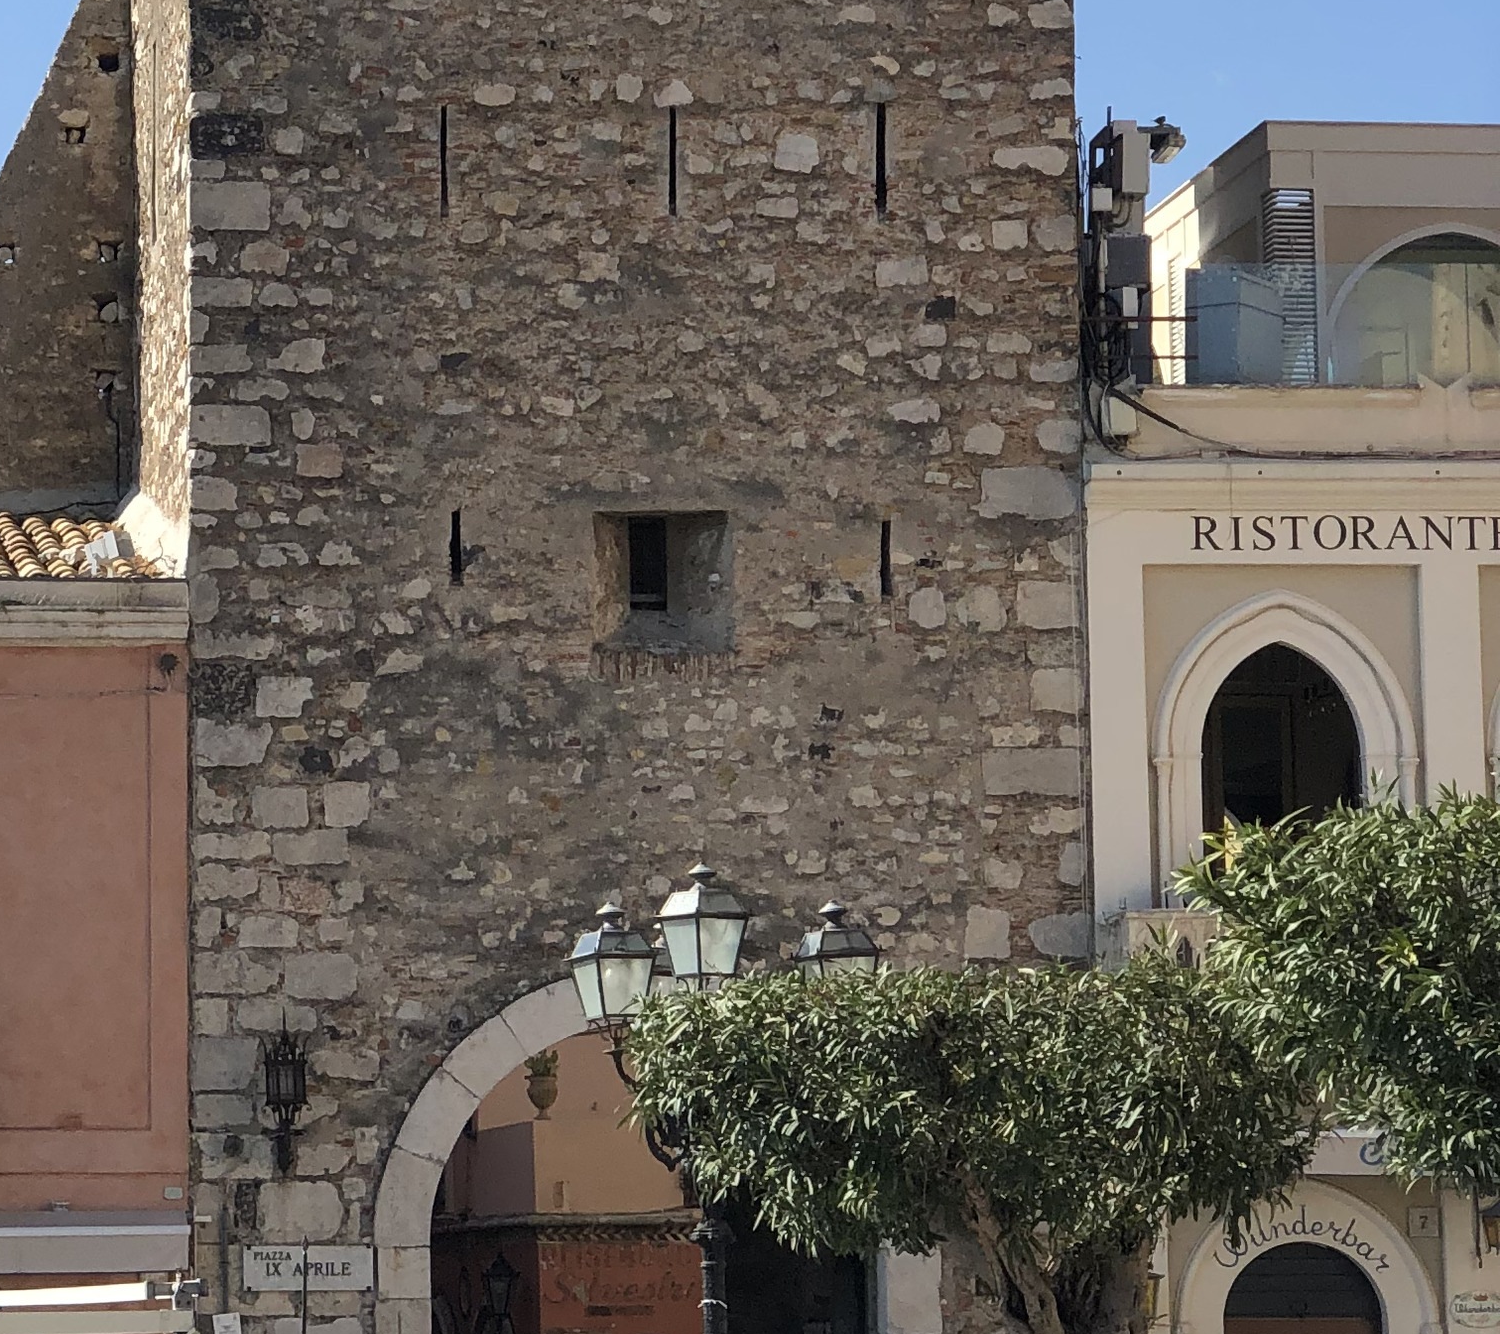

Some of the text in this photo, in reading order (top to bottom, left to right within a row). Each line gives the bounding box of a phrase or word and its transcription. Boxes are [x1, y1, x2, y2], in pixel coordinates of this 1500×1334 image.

[1418, 1215, 1428, 1229] 7
[1213, 1203, 1390, 1273] Wunderbar
[253, 1251, 292, 1261] PIAZZA
[266, 1262, 352, 1277] IX APRILE
